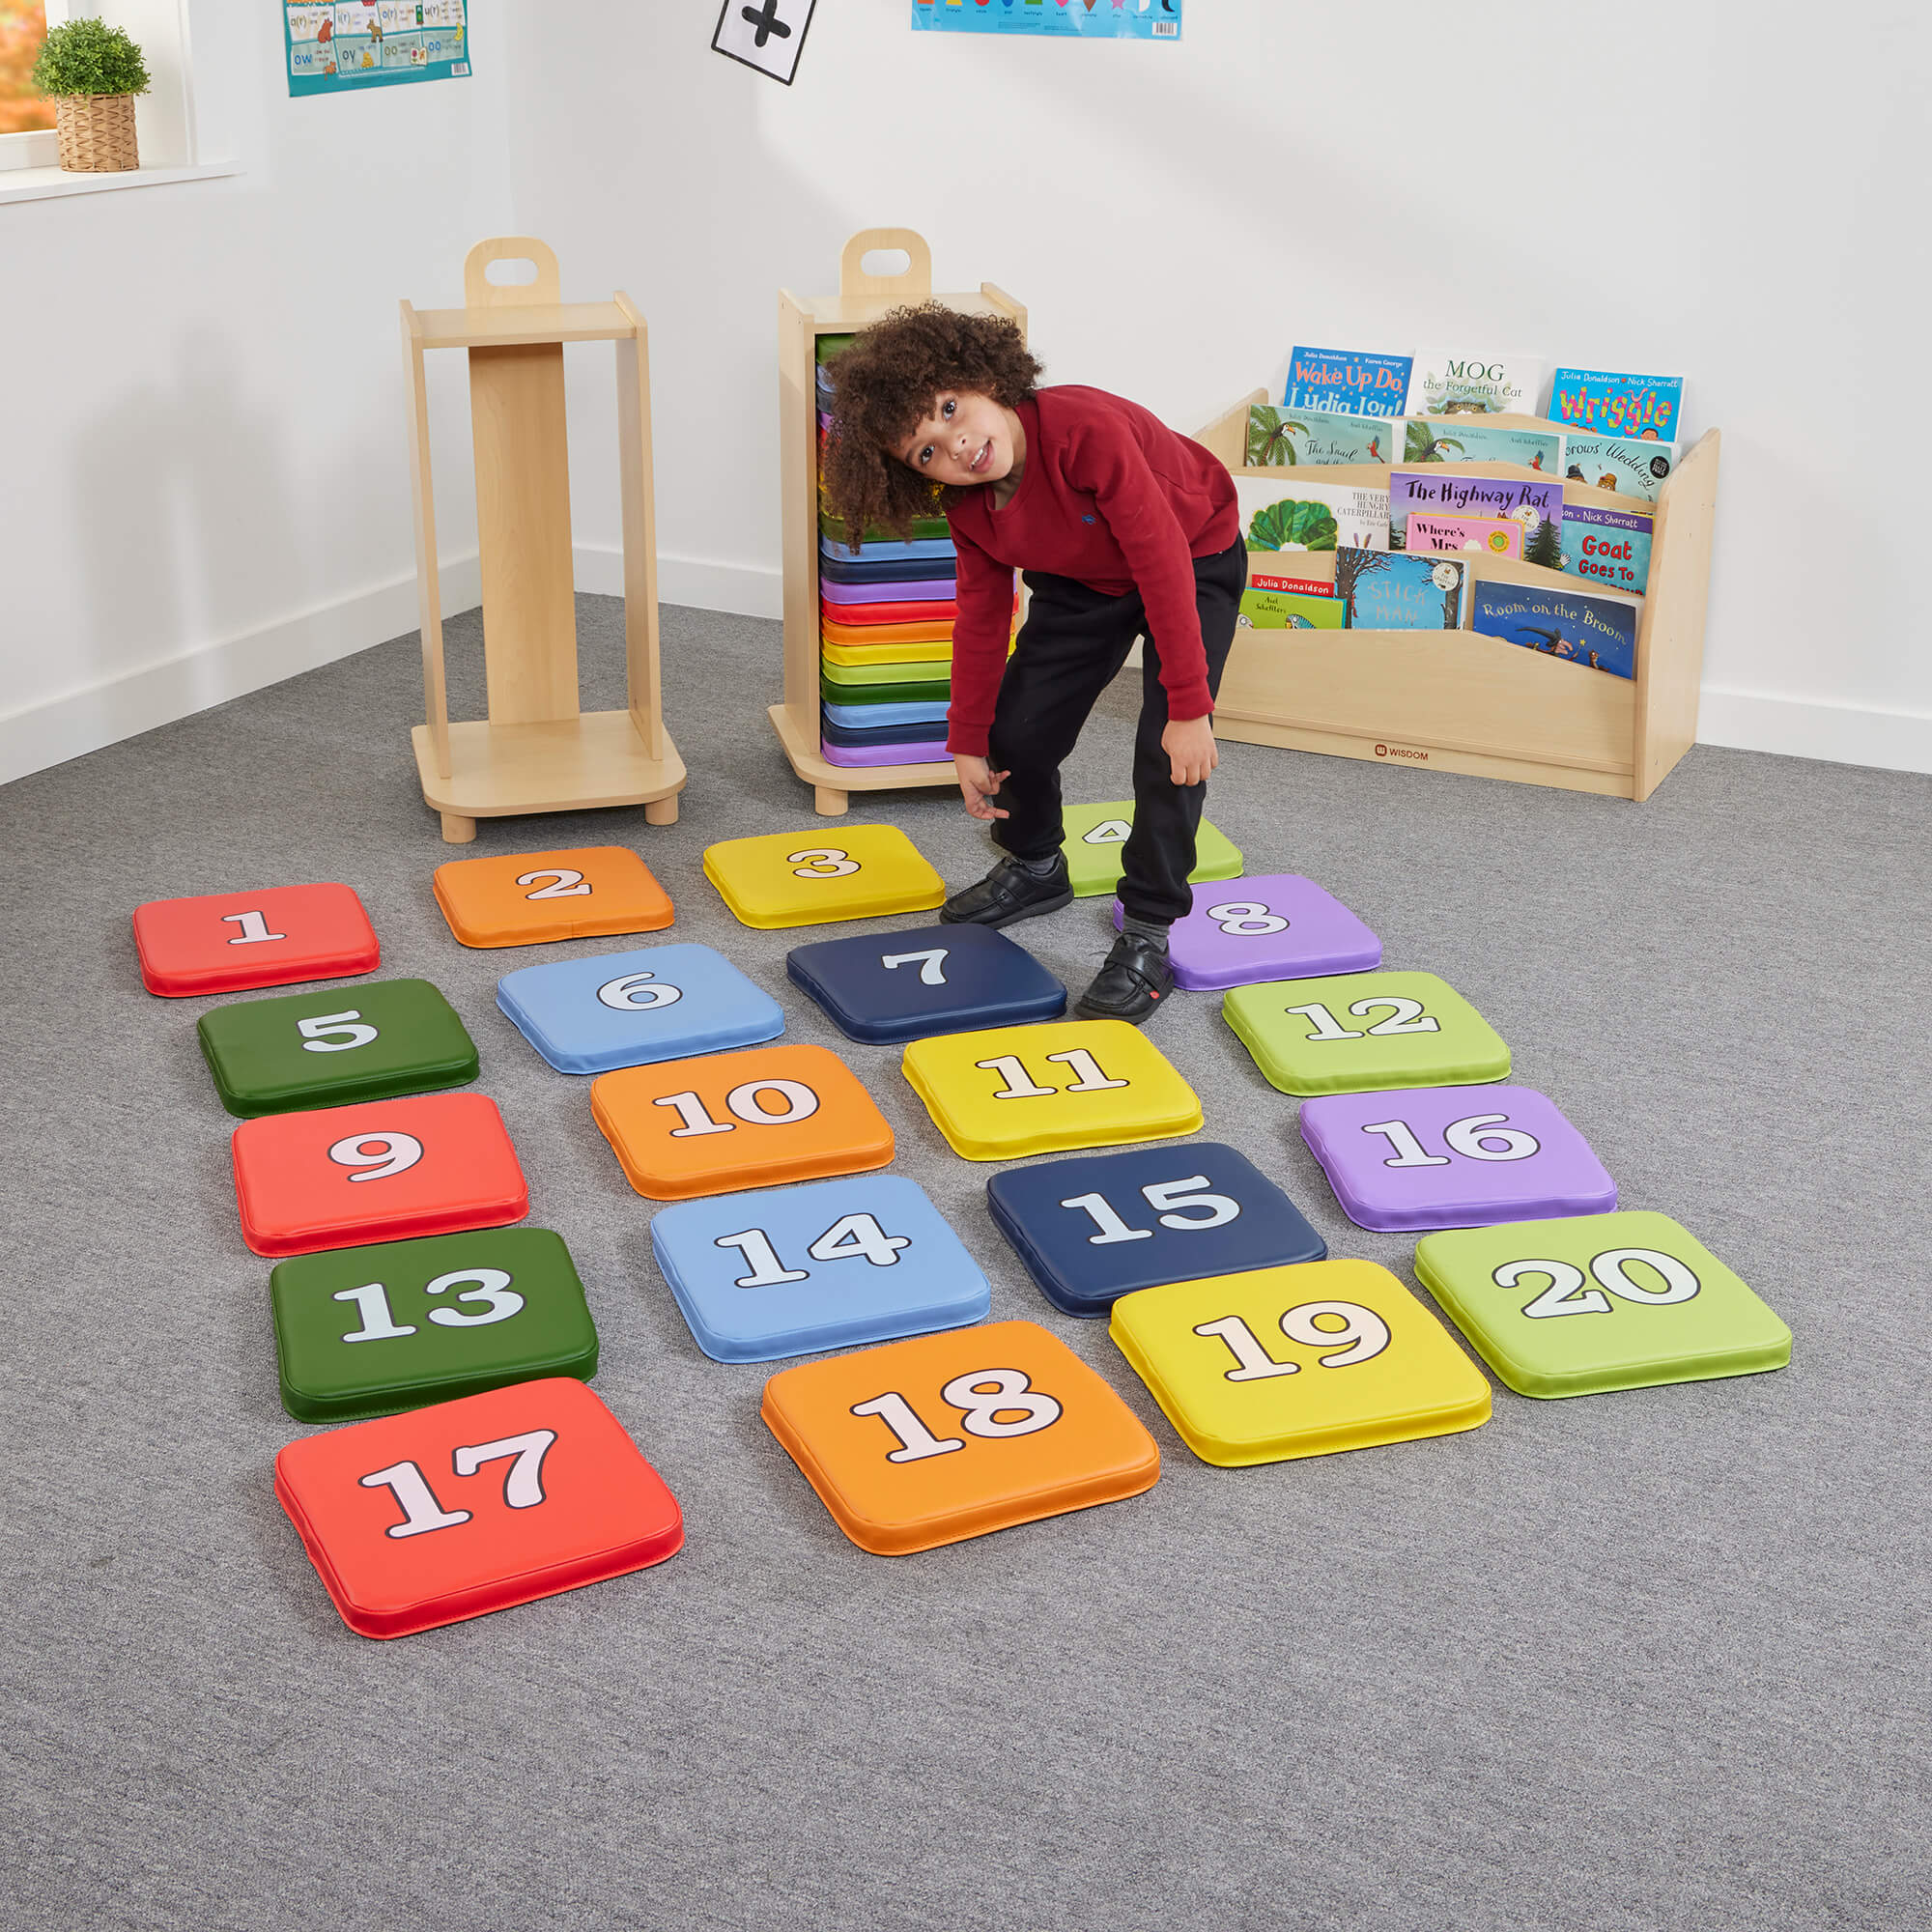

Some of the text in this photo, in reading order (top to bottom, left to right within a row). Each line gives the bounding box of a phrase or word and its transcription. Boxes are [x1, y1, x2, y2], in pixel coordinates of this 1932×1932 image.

[294, 54, 312, 65] ow
[342, 49, 355, 63] oy
[384, 45, 397, 56] oo
[428, 41, 441, 51] oo
[1295, 361, 1343, 385] Wake
[1346, 366, 1373, 392] Up
[1445, 359, 1504, 382] MOG
[1561, 371, 1620, 384] Julia Donaldson
[1628, 378, 1678, 388] Nick Sharratt
[1423, 379, 1522, 398] the Forgetful Cat
[1559, 385, 1672, 435] Wriggle
[1305, 440, 1359, 462] The Snail
[1605, 442, 1655, 491] Wedding
[1352, 492, 1390, 503] THE VERY
[1357, 501, 1390, 511] HUNGRY
[1406, 479, 1550, 511] The Highway Rat
[1416, 523, 1465, 537] Where's
[1583, 511, 1604, 522] Nick
[1605, 515, 1638, 528] Sharratt
[1430, 538, 1459, 551] Mrs
[1582, 535, 1633, 560] Goat
[1578, 559, 1634, 581] Goes To
[1257, 579, 1329, 594] Julia Donaldson
[1368, 581, 1429, 606] STICK
[1376, 604, 1418, 626] MAN
[1483, 603, 1627, 645] Room on the Broom
[1389, 748, 1429, 761] WISDOM
[785, 847, 862, 878] 3
[516, 868, 593, 900] 2
[220, 910, 287, 946] 1
[1206, 901, 1290, 936] 8
[880, 948, 950, 986] 7
[596, 971, 683, 1011] 6
[296, 1009, 380, 1053] 5
[1285, 996, 1441, 1041] 12
[973, 1047, 1131, 1101] 11
[651, 1078, 820, 1138] 10
[1362, 1113, 1542, 1168] 16
[327, 1131, 425, 1183] 9
[1058, 1174, 1243, 1246] 15
[713, 1212, 913, 1291] 14
[1491, 1247, 1702, 1321] 20
[331, 1267, 527, 1345] 13
[1192, 1298, 1393, 1383] 19
[850, 1367, 1066, 1464] 18
[357, 1428, 560, 1540] 17
